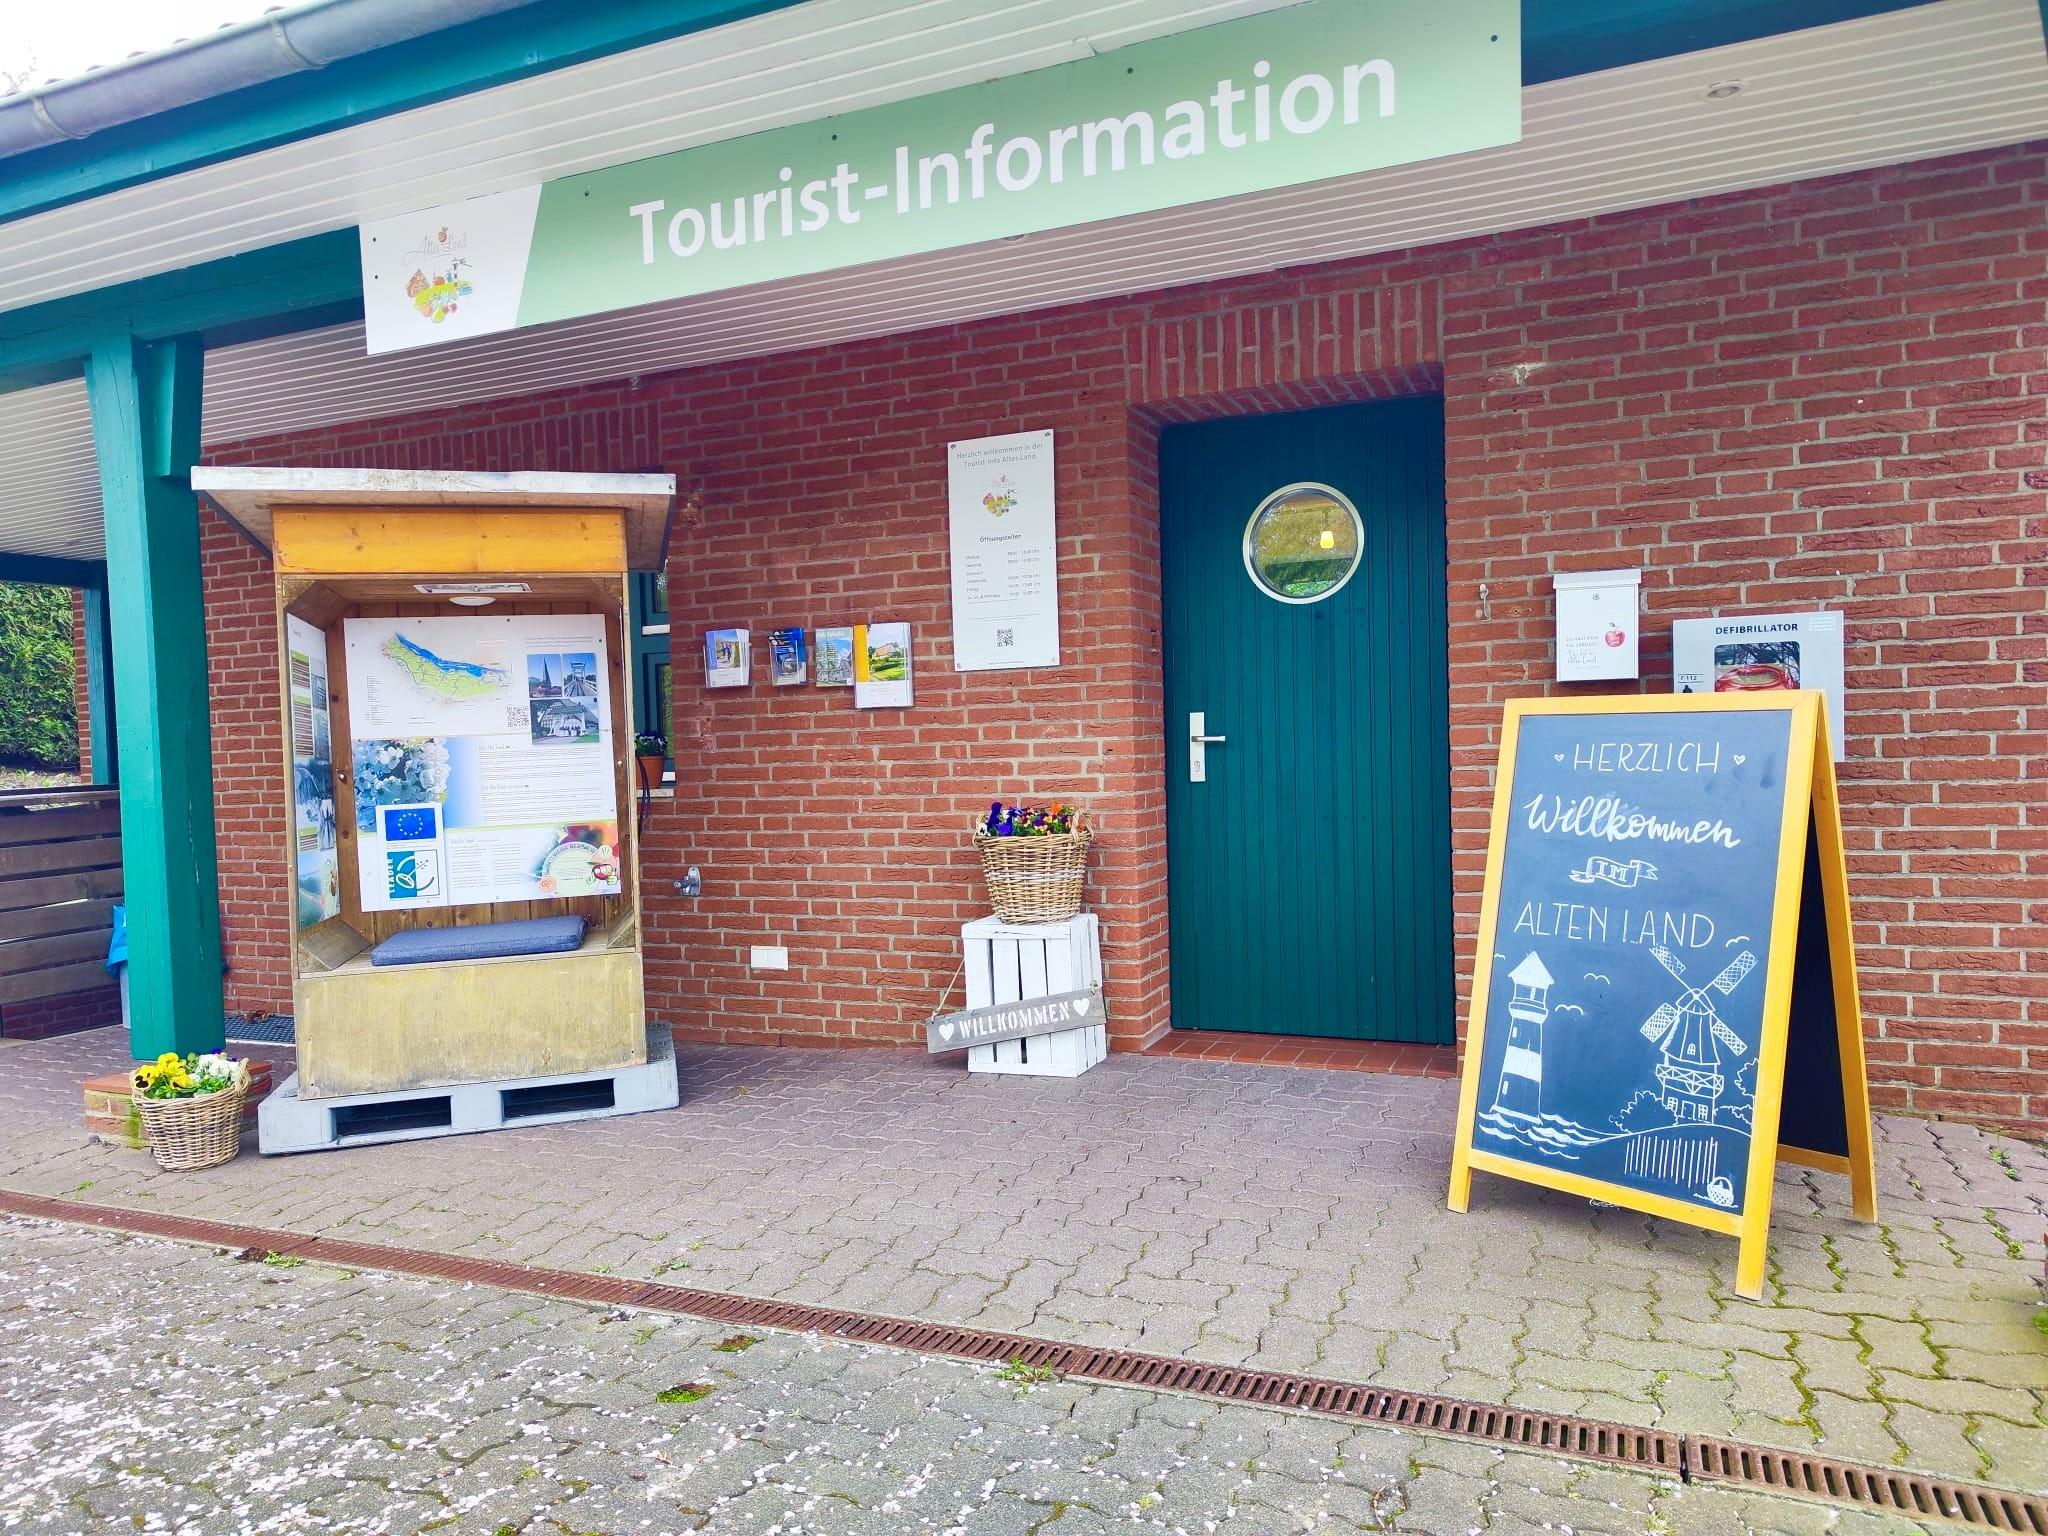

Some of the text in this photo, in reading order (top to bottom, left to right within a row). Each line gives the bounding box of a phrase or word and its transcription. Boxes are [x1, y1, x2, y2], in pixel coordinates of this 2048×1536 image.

[629, 57, 1397, 264] Tourist-Information
[956, 450, 982, 460] Herzlich
[983, 446, 1023, 457] willkommen
[1032, 442, 1043, 450] der
[1002, 456, 1018, 464] Altes
[1020, 453, 1036, 461] Land
[1715, 623, 1798, 635] DEFIBRILLATOR
[1573, 741, 1721, 774] HERZLICH
[1523, 793, 1741, 848] Willkommen
[1595, 861, 1628, 883] IM
[1514, 901, 1716, 949] ALTEN LAND
[958, 1001, 1070, 1039] WILLKOMMEN
